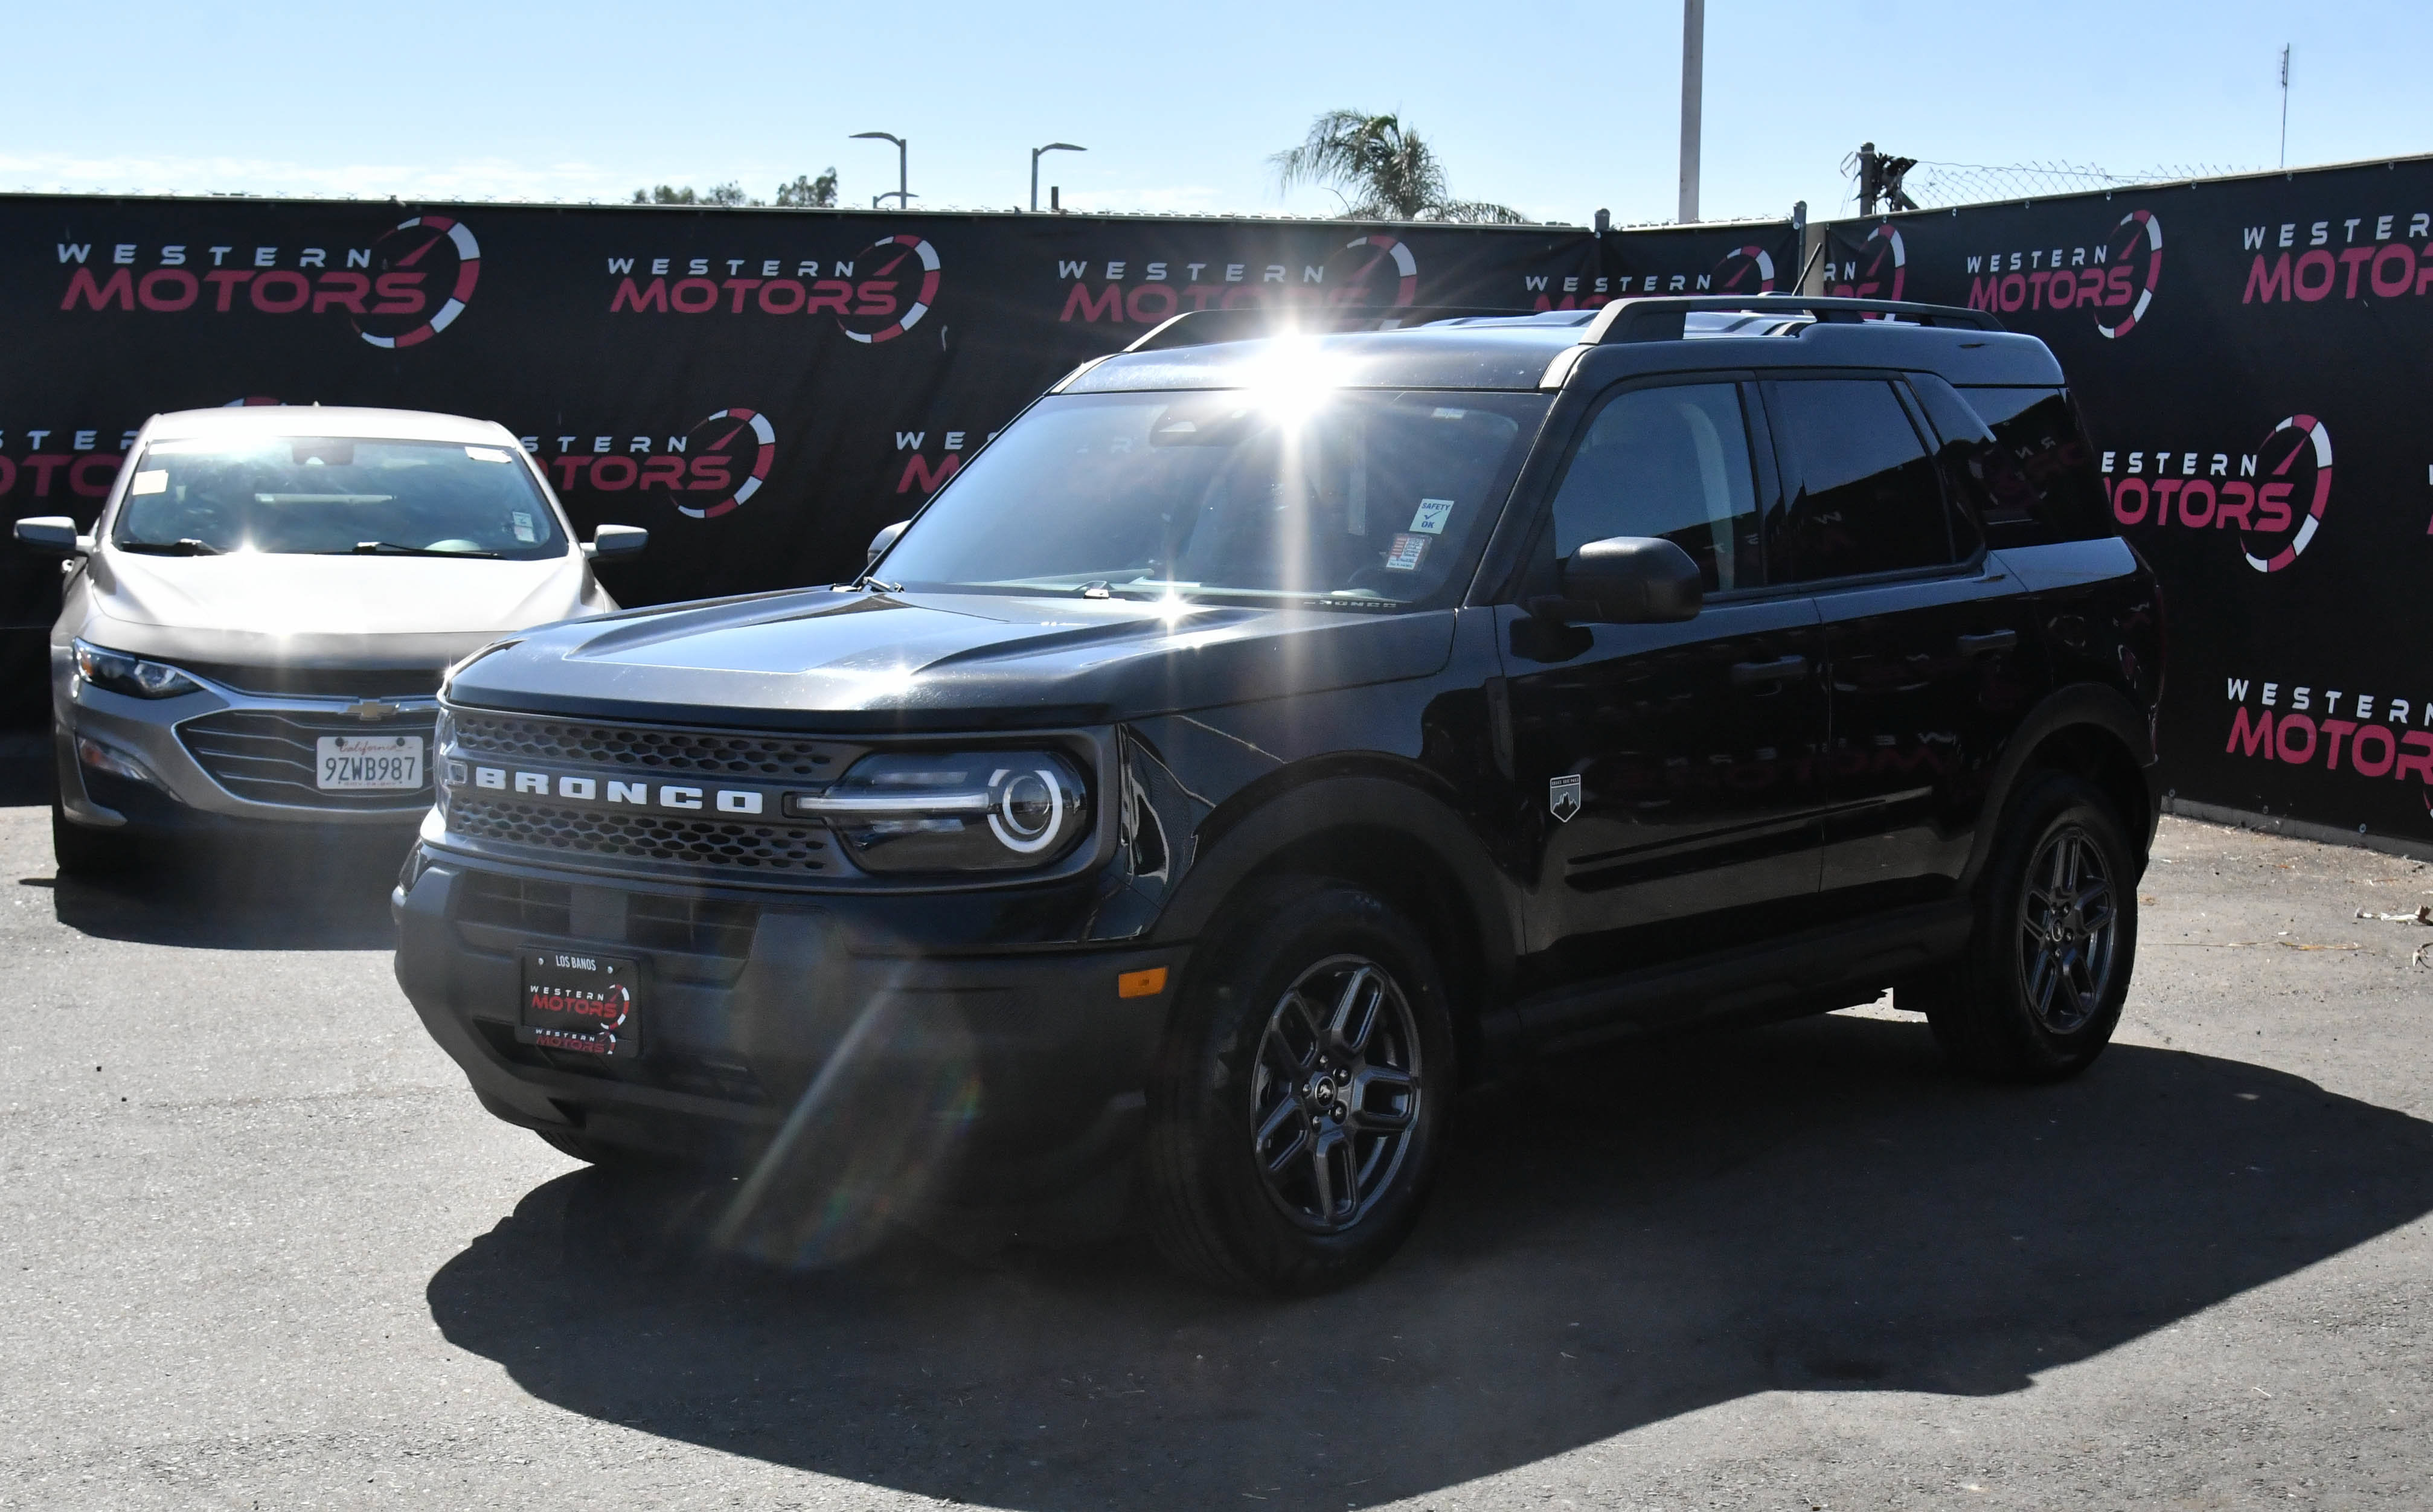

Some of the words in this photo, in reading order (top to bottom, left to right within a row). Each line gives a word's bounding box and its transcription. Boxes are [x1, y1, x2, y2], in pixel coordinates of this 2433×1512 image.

[2243, 213, 2430, 250] WESTER
[57, 243, 371, 268] WESTERN
[607, 257, 854, 277] WESTERN
[1967, 245, 2108, 274] WESTERN
[1059, 260, 1324, 283] WESTERN
[1525, 274, 1711, 292] WESTERN
[2242, 242, 2433, 304] MOTO
[61, 267, 427, 314] MOTORS
[610, 277, 898, 315] MOTORS
[1967, 265, 2133, 313] MOTORS
[520, 435, 687, 453] STERN
[534, 455, 731, 491] TORS
[2101, 451, 2257, 477] ESTERN
[1421, 502, 1451, 511] SAFETY
[2104, 476, 2294, 532] OTORS
[339, 740, 400, 755] California
[2225, 705, 2433, 785] MOTOR
[325, 756, 416, 781] 9ZWB987
[475, 766, 763, 814] BRONCO
[556, 955, 570, 967] LOS
[571, 956, 597, 971] BANOS
[530, 985, 604, 1001] WESTERN
[531, 993, 617, 1018] MOTORS
[535, 1028, 595, 1042] WESTERN
[536, 1036, 604, 1053] MOTORS
